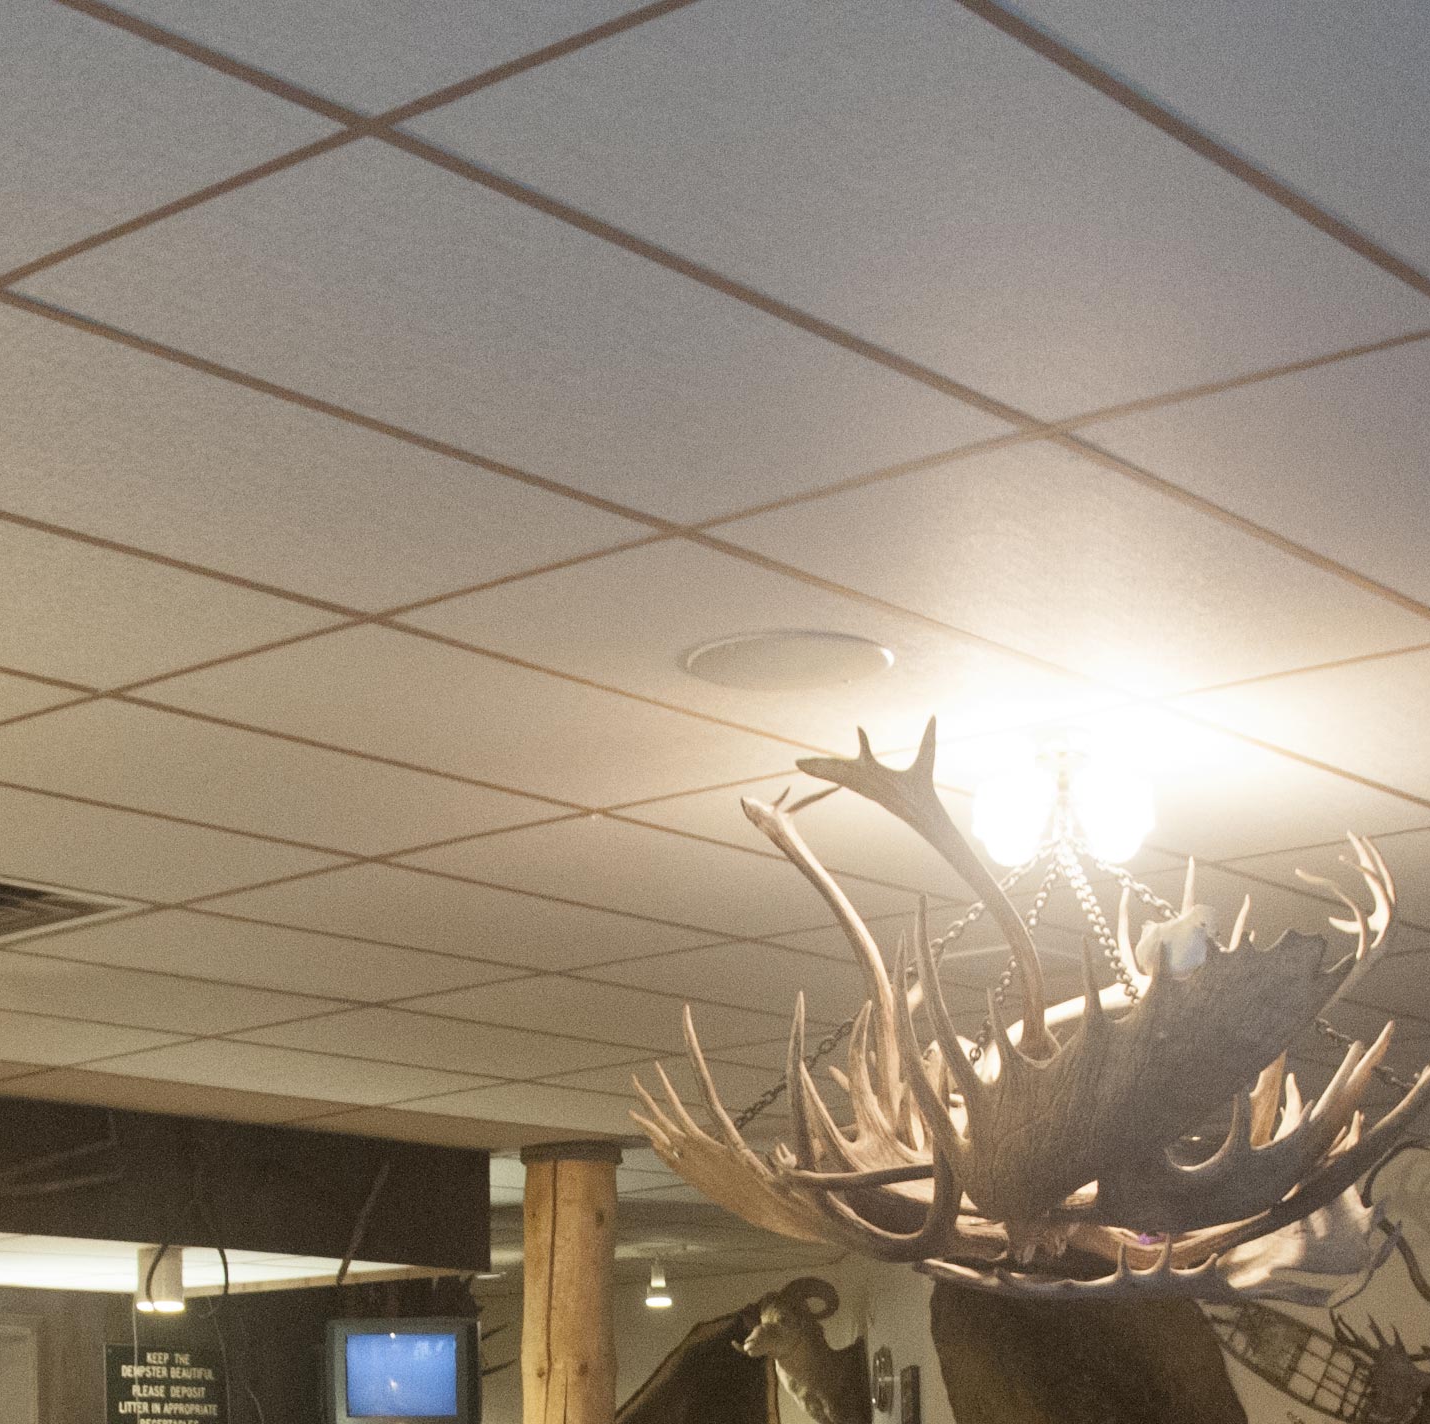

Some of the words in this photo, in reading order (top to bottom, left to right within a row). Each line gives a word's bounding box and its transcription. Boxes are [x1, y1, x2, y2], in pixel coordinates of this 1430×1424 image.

[146, 1352, 169, 1365] KEEP
[175, 1353, 191, 1365] THE
[121, 1365, 167, 1379] DEMPSTER
[170, 1366, 215, 1380] BEAUTIFUL
[132, 1385, 165, 1398] PLEASE
[170, 1386, 206, 1399] DEPOSIT
[118, 1401, 149, 1414] LITTER
[151, 1402, 161, 1415] IN
[163, 1403, 218, 1416] APPROPRIATE
